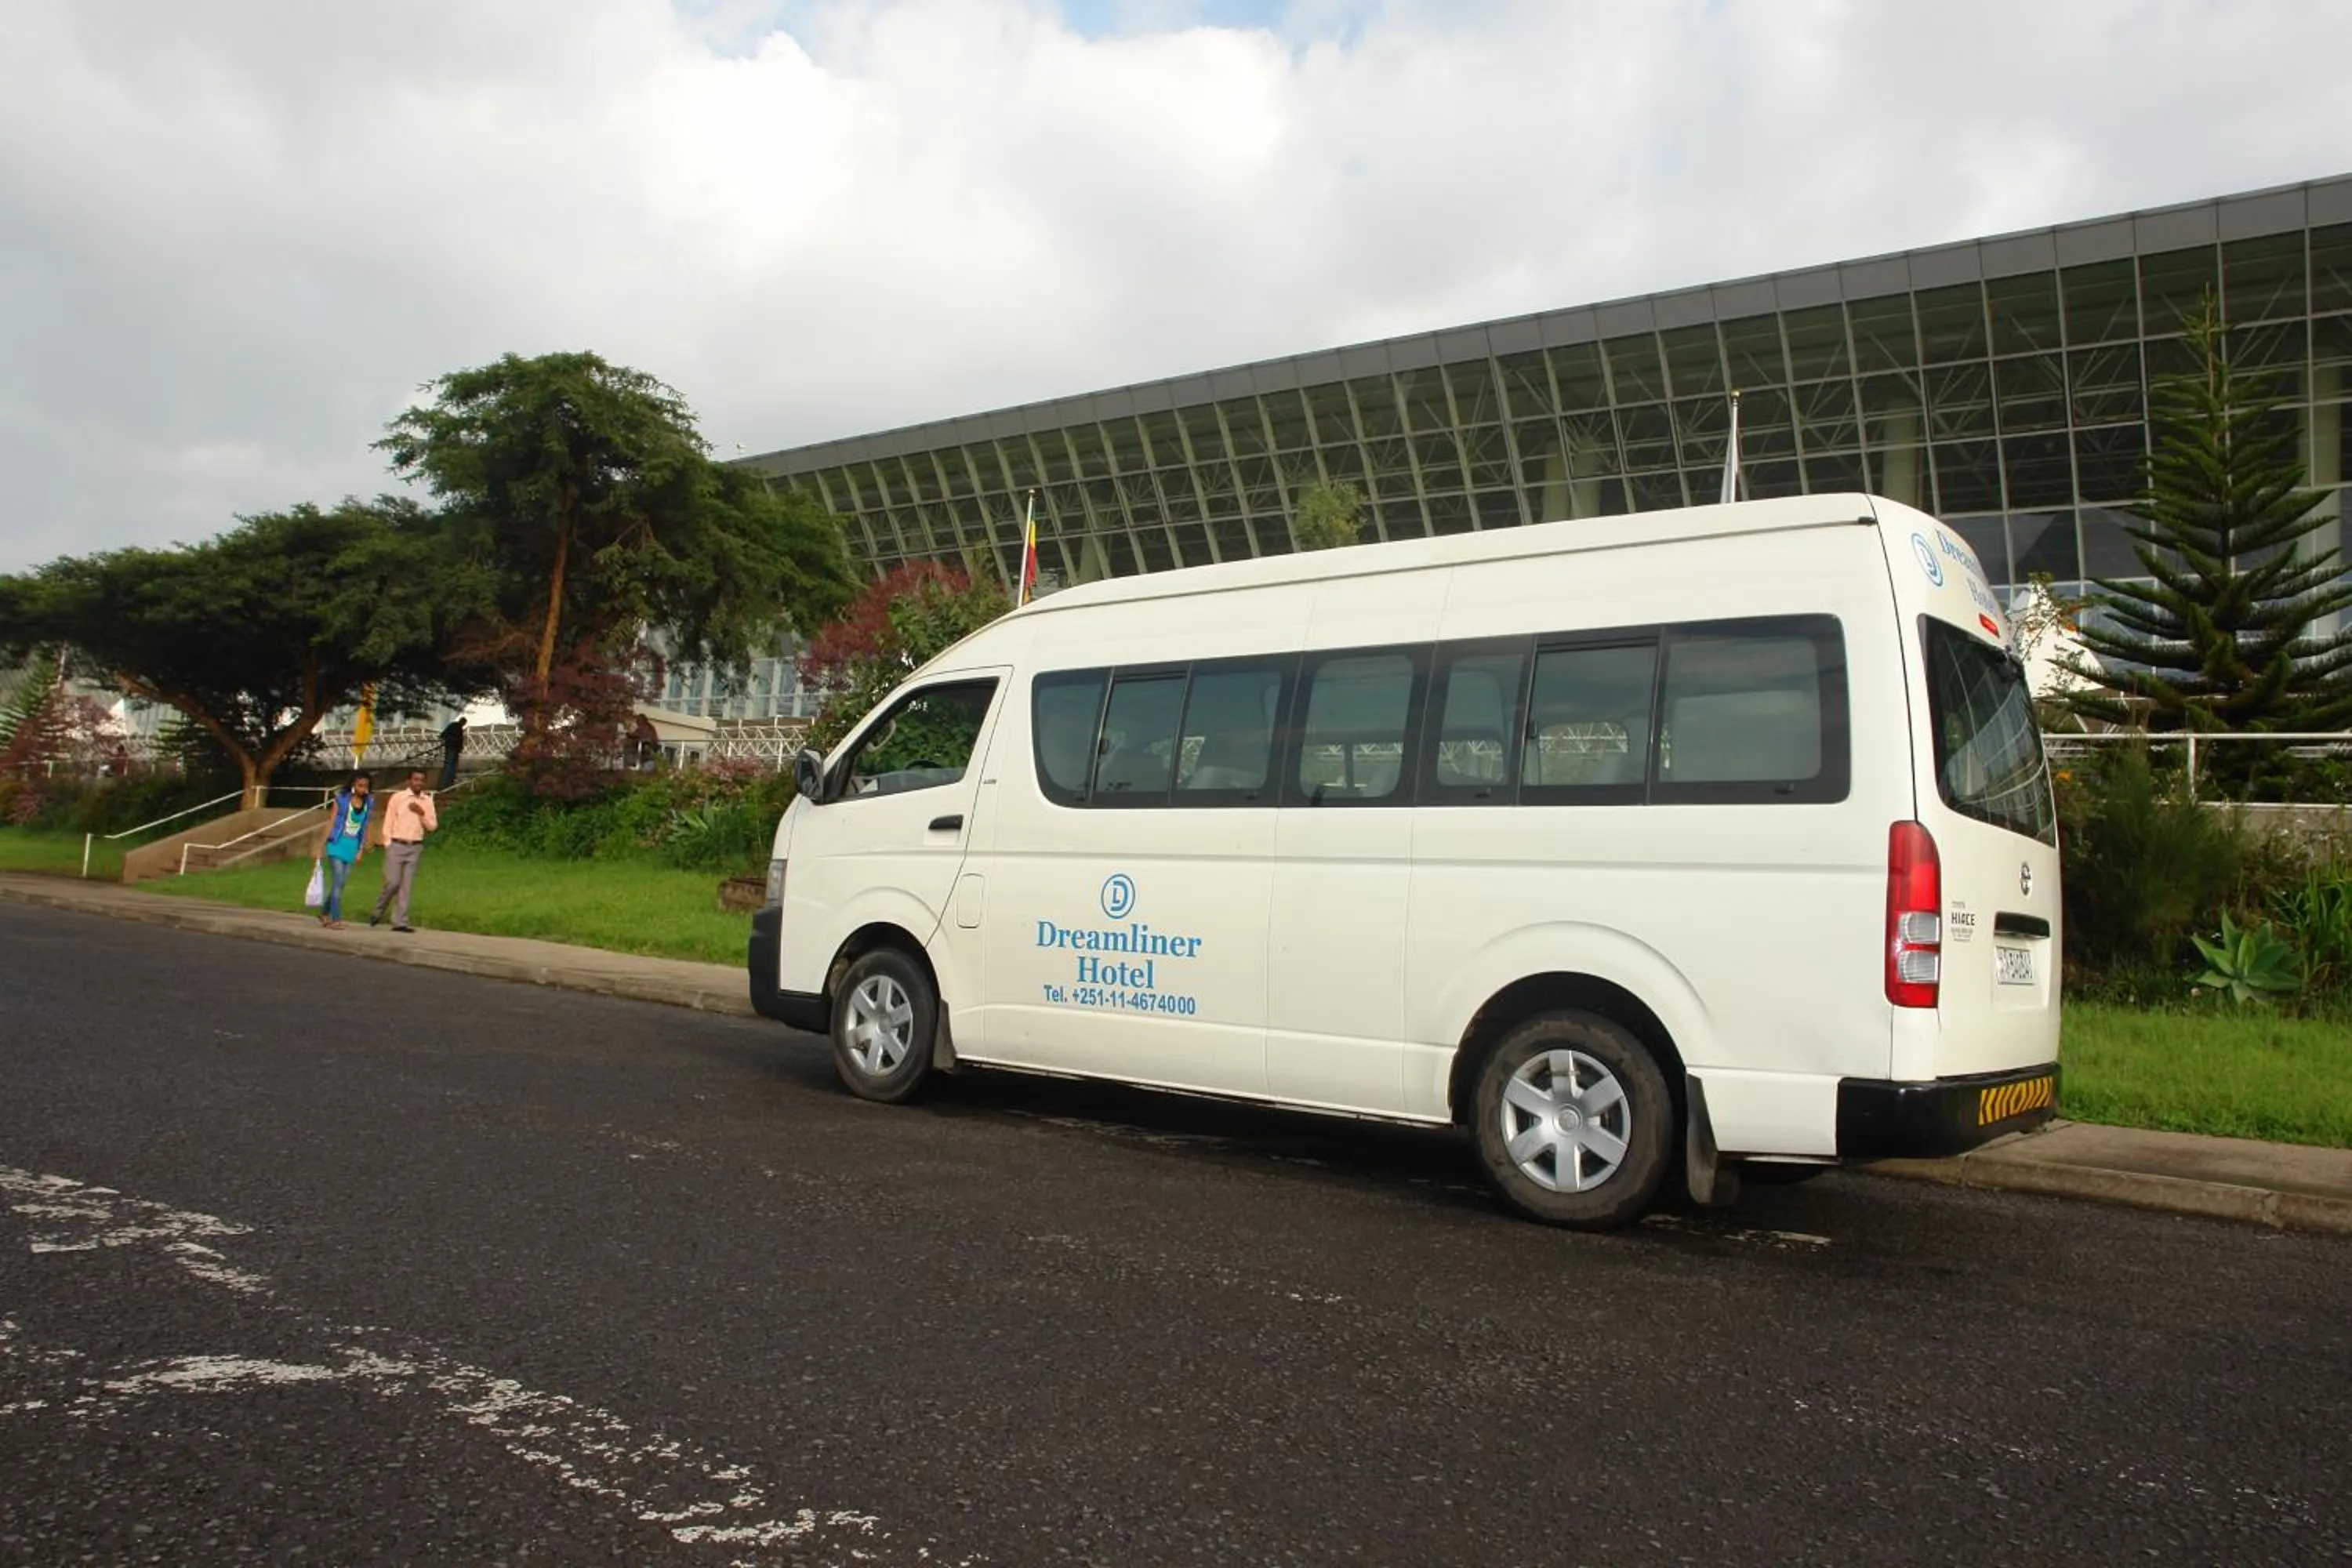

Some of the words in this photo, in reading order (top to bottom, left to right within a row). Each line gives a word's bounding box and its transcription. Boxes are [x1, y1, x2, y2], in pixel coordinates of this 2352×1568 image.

[1951, 912, 1976, 926] HIACE
[1036, 920, 1202, 958] Dreamliner
[1076, 955, 1155, 989] Hotel
[1044, 984, 1068, 1004] Tel.
[1072, 987, 1196, 1015] +251-11-4674000
